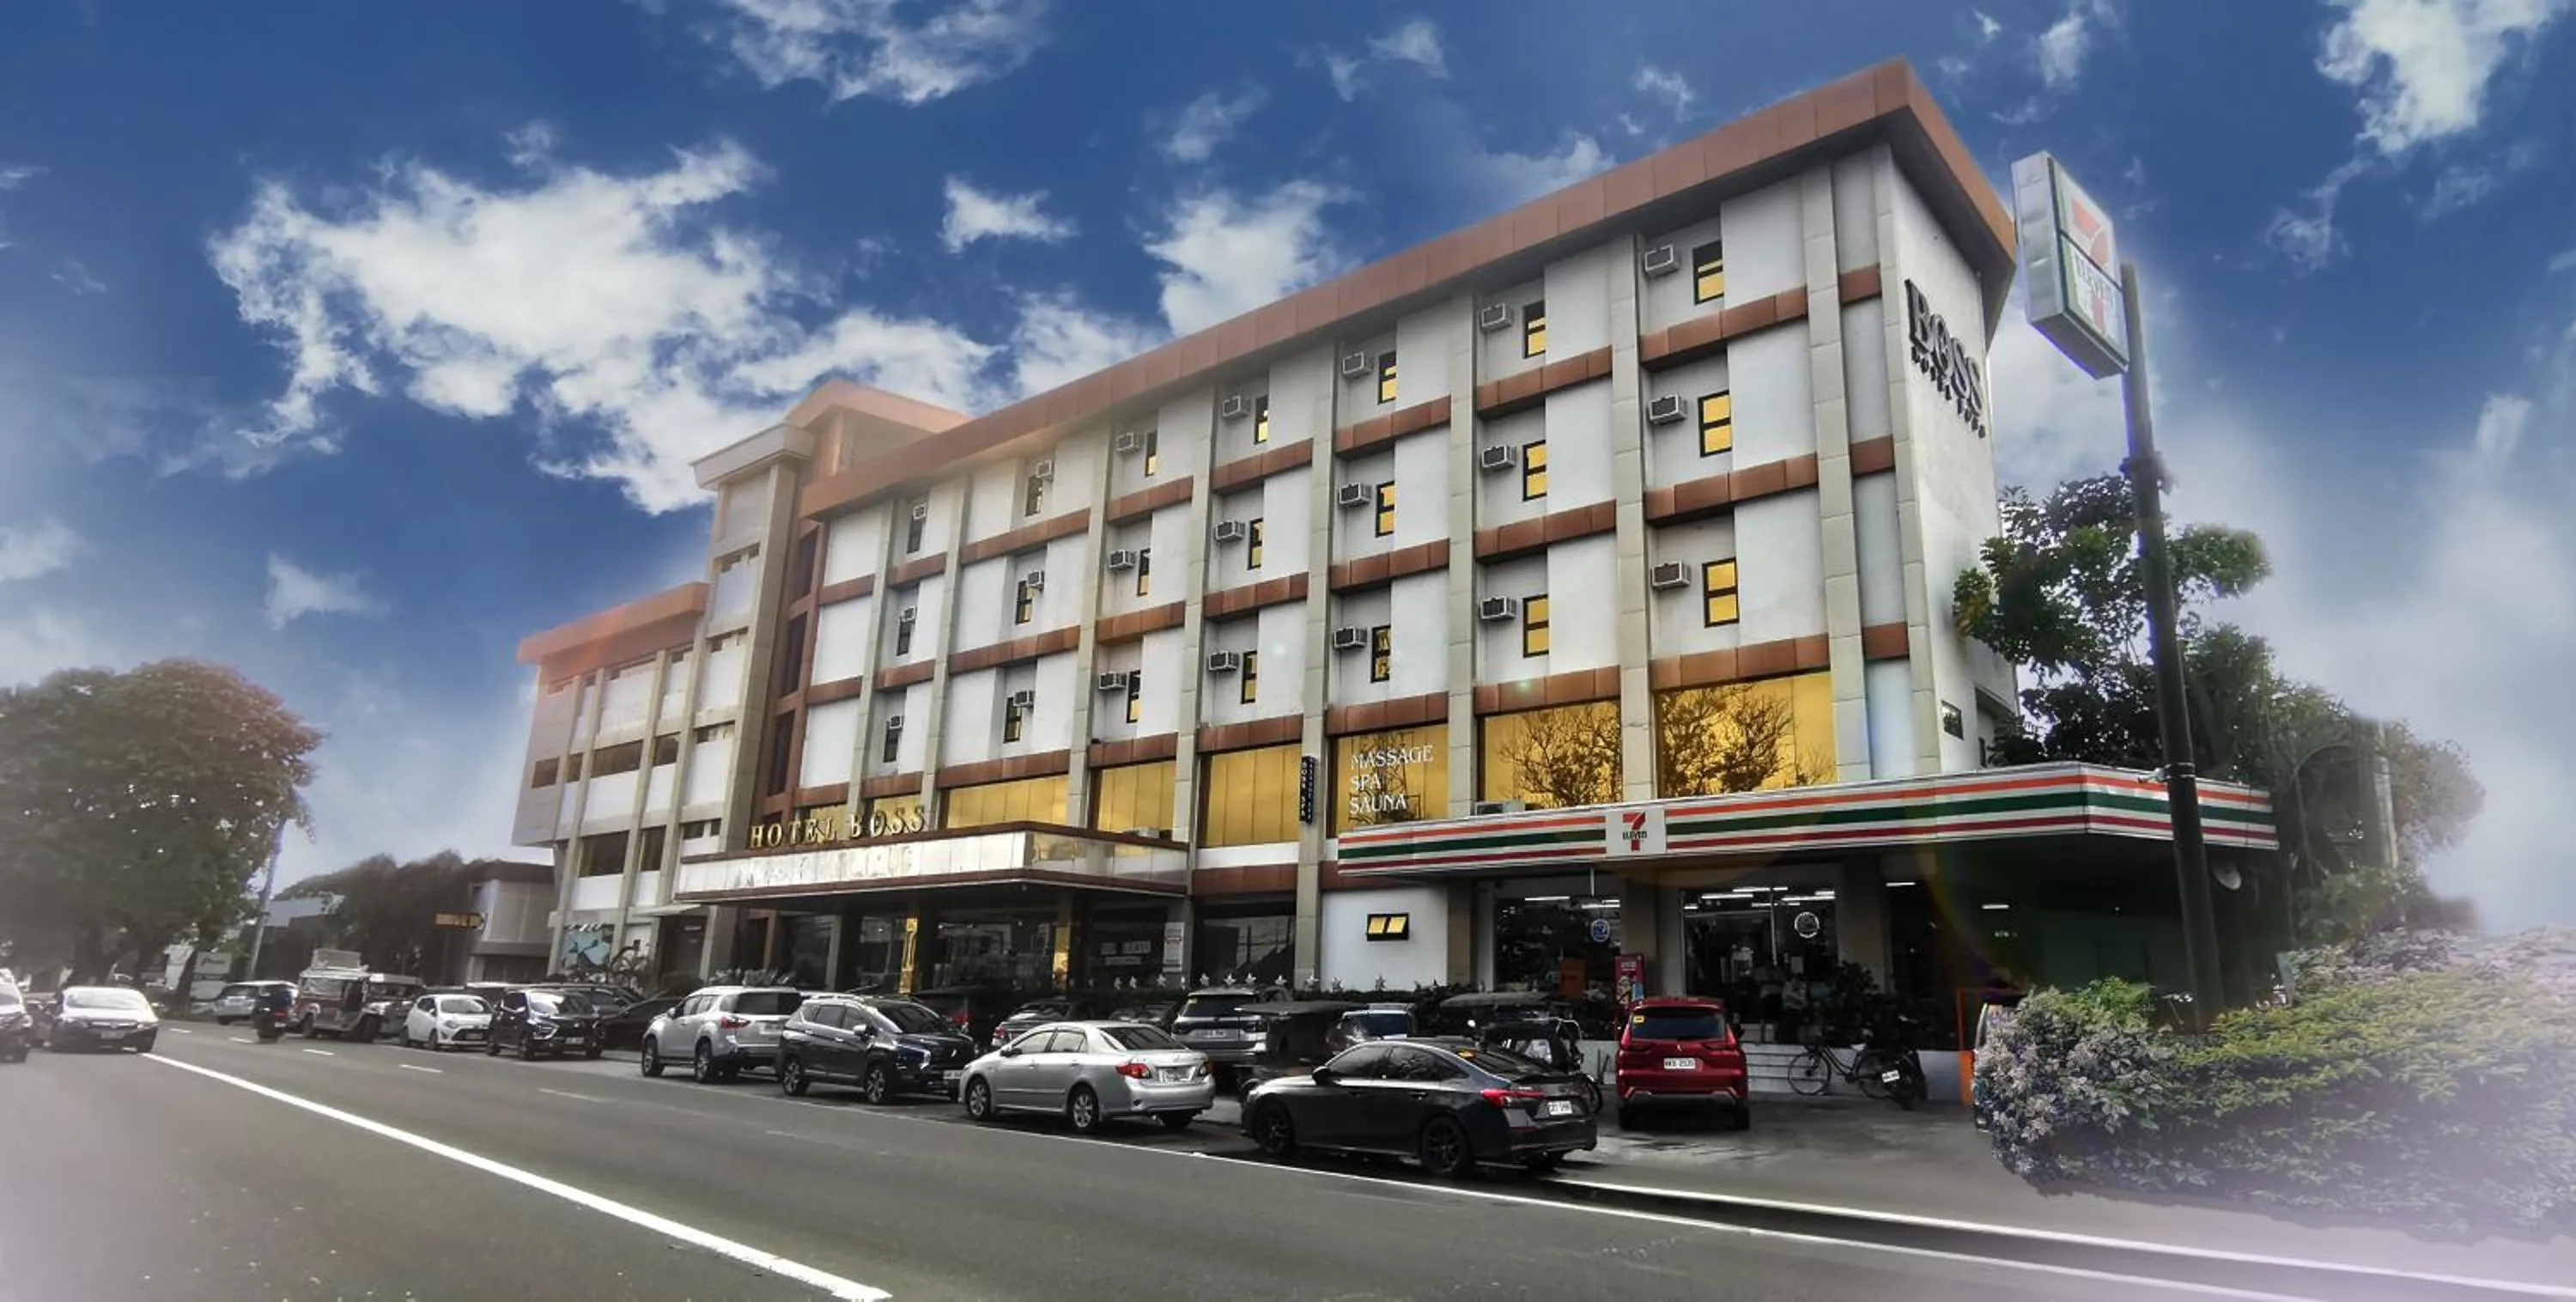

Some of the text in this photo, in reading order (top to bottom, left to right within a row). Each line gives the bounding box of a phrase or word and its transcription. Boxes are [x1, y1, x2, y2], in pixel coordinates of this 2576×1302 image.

[1905, 278, 1983, 417] BOSS
[1351, 745, 1433, 770] MASSAGE
[1350, 773, 1382, 792] SPA
[1350, 794, 1407, 815] SAUNA
[750, 805, 925, 849] HOTEL BOSS
[1622, 811, 1647, 852] 7
